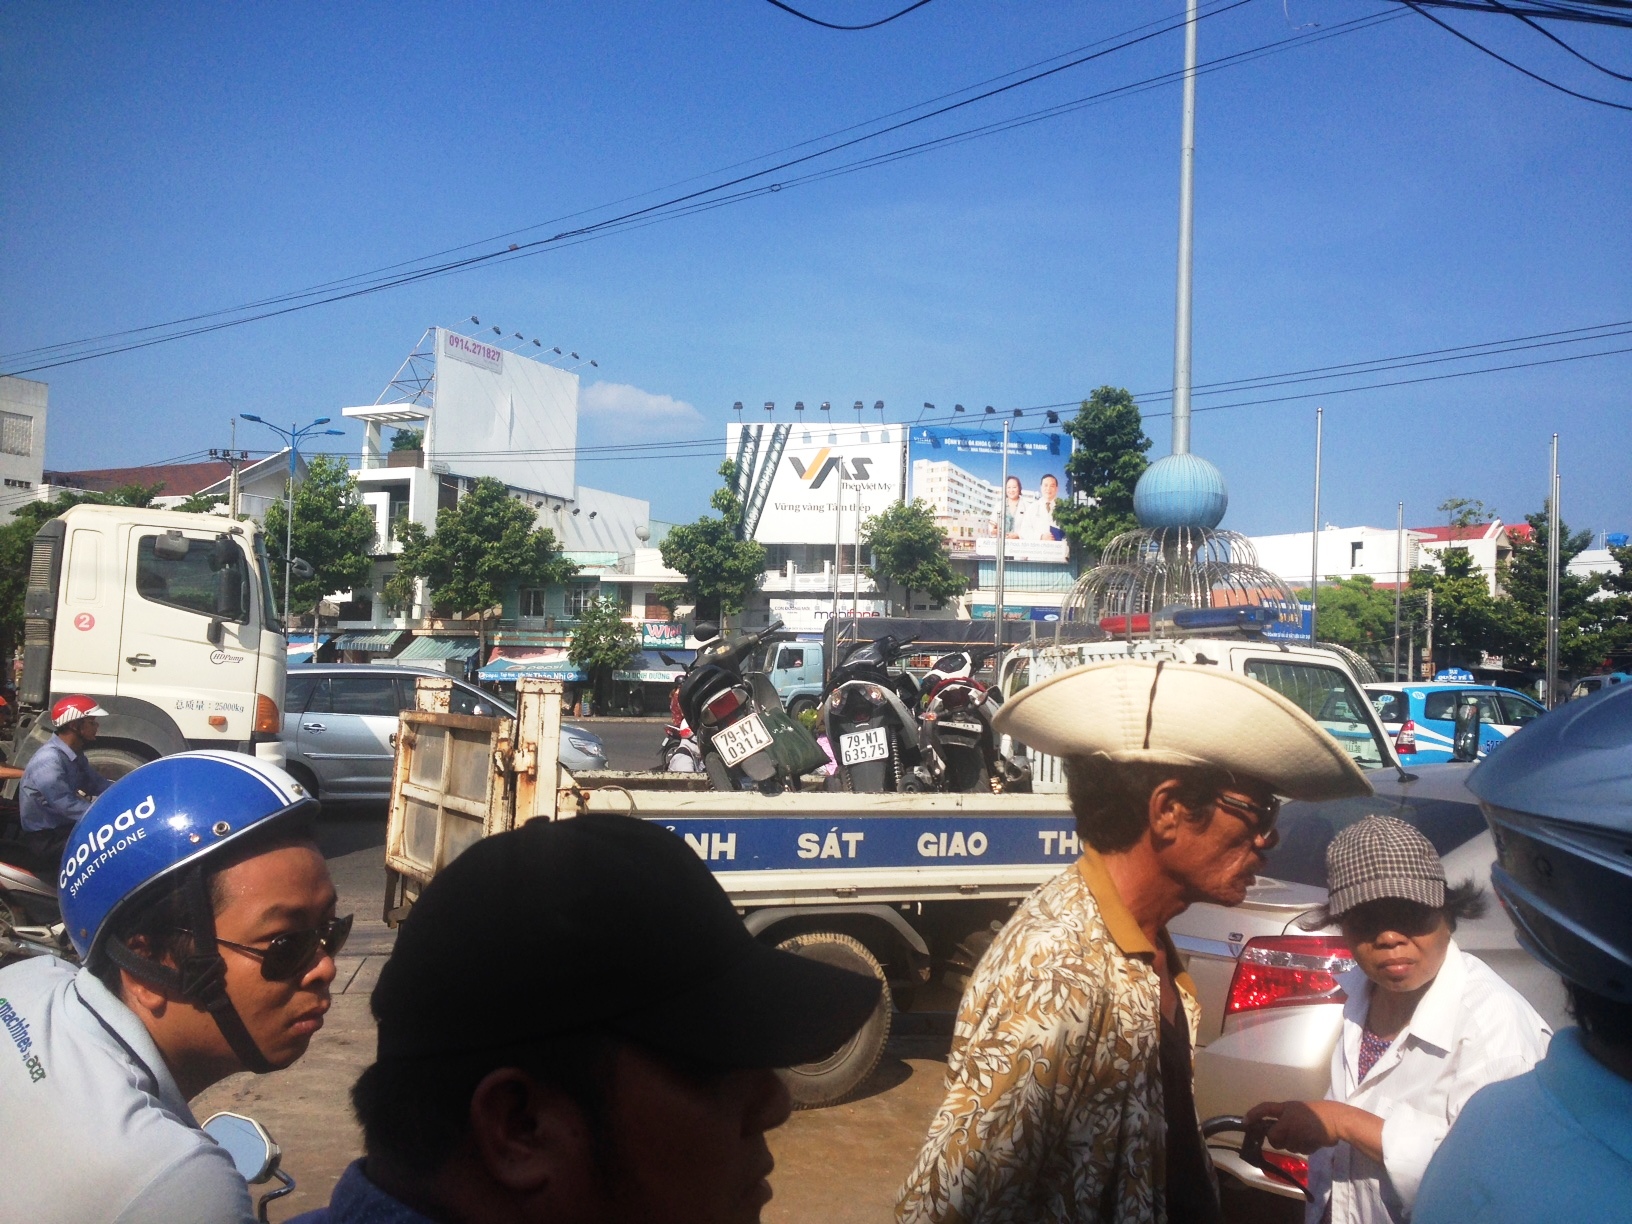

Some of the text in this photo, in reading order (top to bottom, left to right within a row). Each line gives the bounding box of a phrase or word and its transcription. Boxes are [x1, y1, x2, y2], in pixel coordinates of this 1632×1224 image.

[449, 335, 501, 362] 0914.271827
[774, 502, 801, 513] Vững
[802, 502, 825, 513] vàng
[79, 615, 90, 628] 2
[720, 720, 755, 747] 79-K7
[847, 731, 878, 748] 79-N1
[844, 743, 885, 762] 635.75
[60, 795, 156, 889] coolpad
[666, 826, 1084, 860] NH SÁT GIAO TH
[69, 827, 147, 896] SMARTPHONE
[26, 1055, 46, 1083] acer
